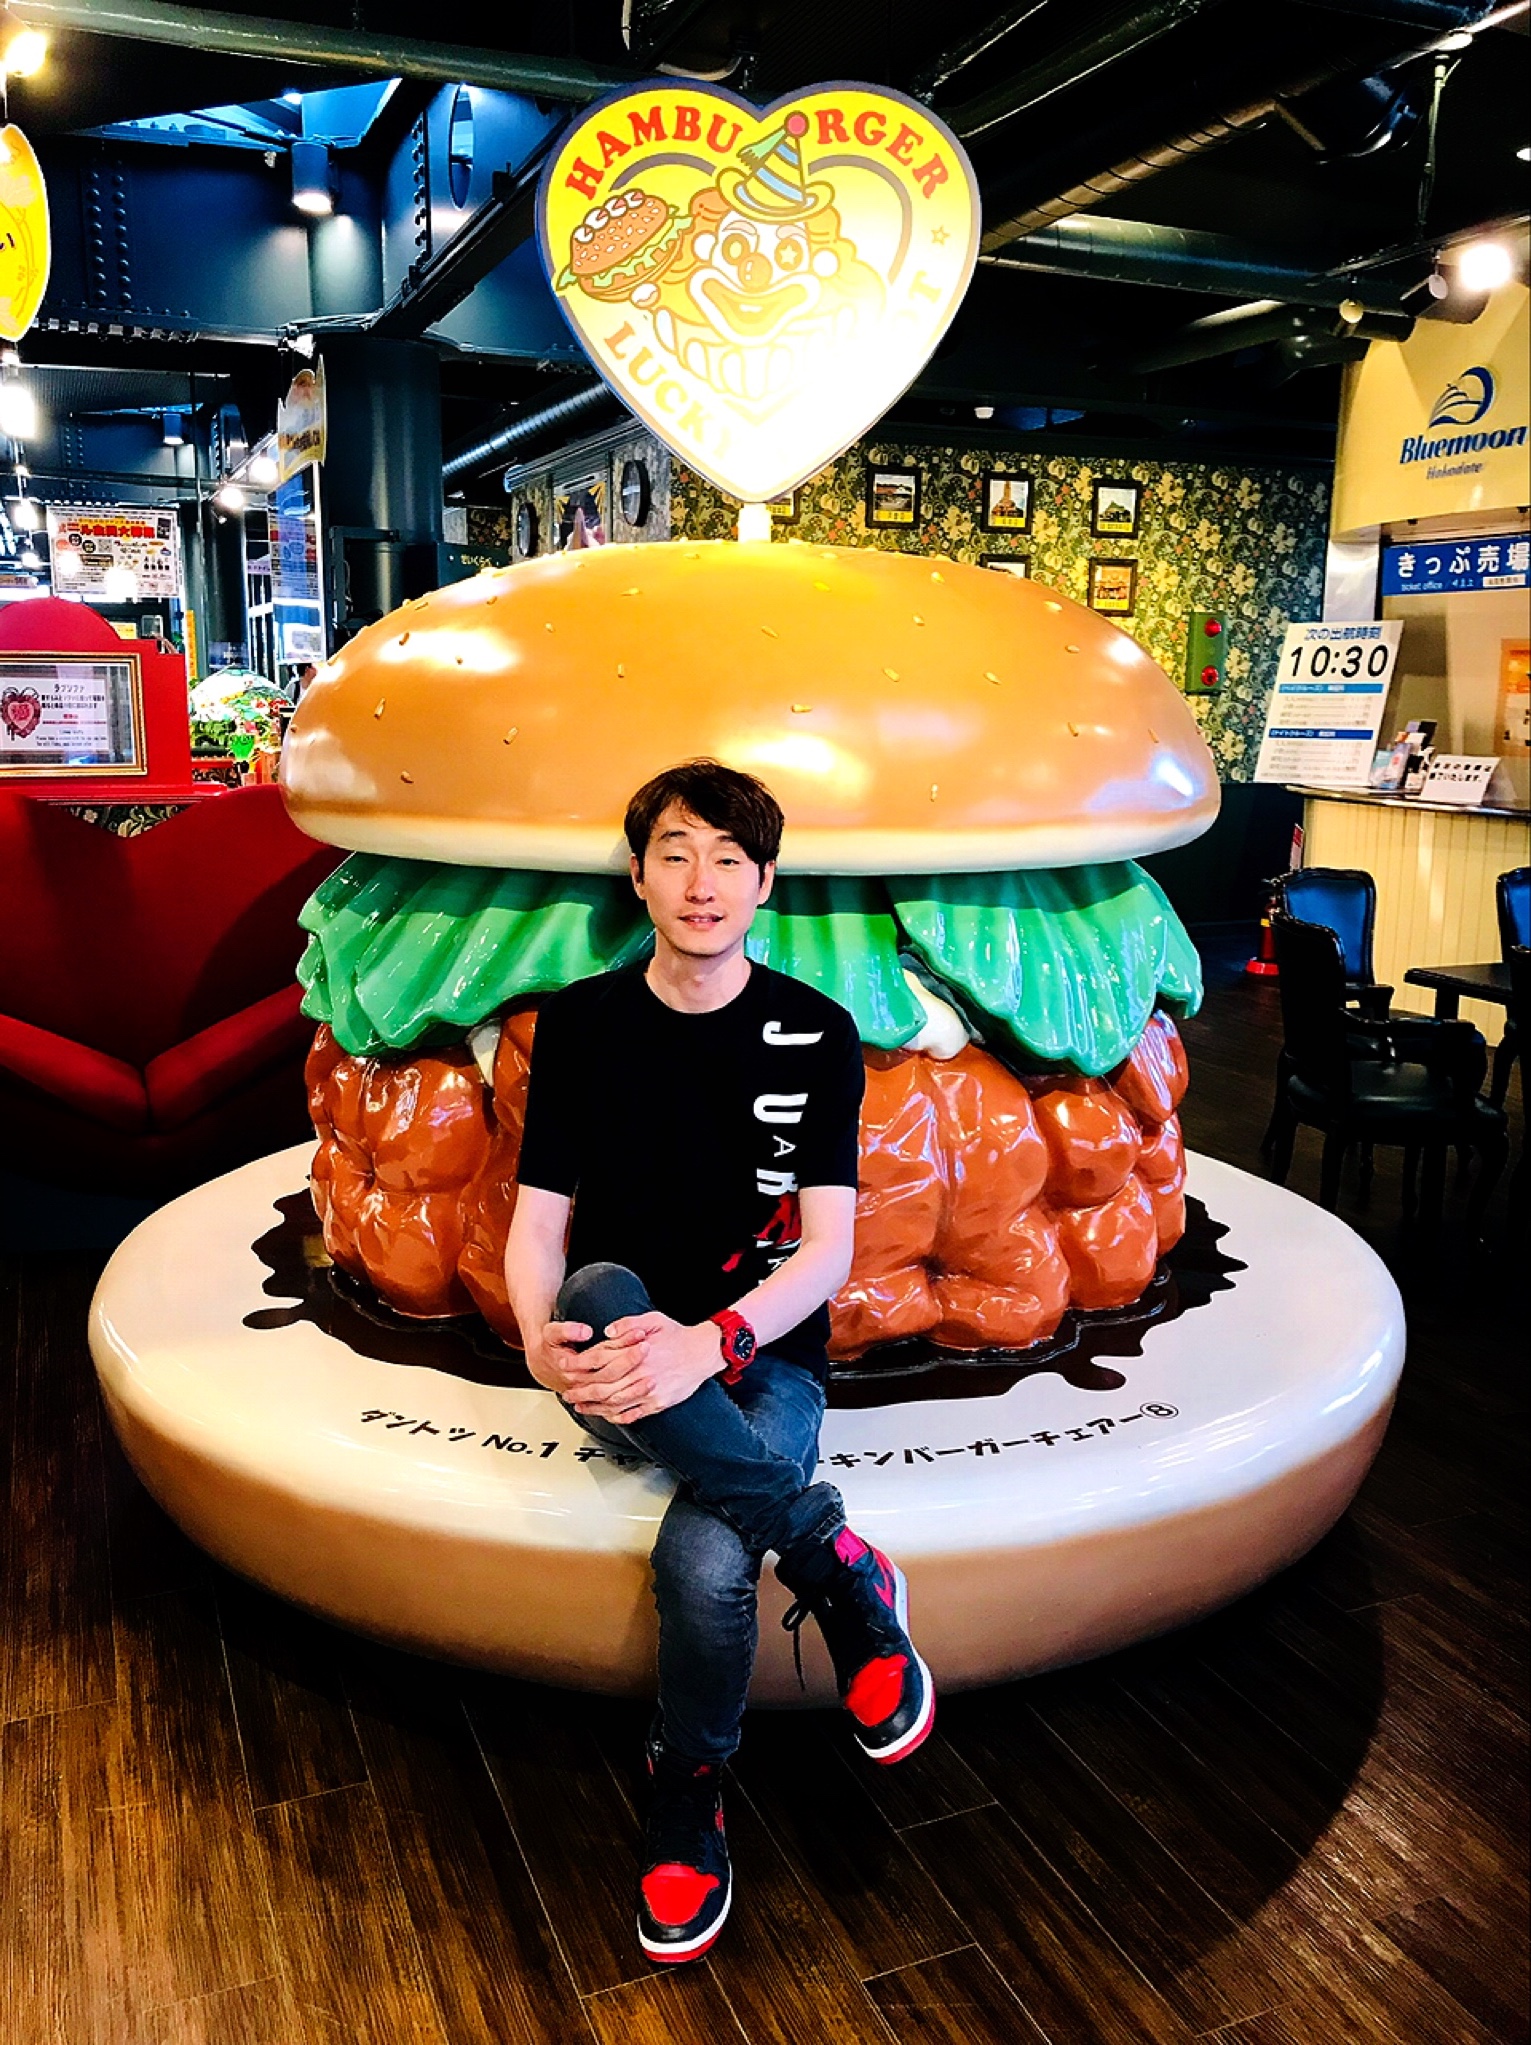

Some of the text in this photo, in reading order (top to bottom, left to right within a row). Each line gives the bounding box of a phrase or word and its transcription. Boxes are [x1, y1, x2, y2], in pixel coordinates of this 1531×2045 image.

[565, 106, 949, 199] HAMBURGER
[1400, 426, 1528, 464] Bluemoon
[1398, 542, 1530, 577] きっぷ売場
[1291, 645, 1389, 677] 10:30
[361, 1409, 476, 1442] ダントツ
[481, 1434, 560, 1459] No.1
